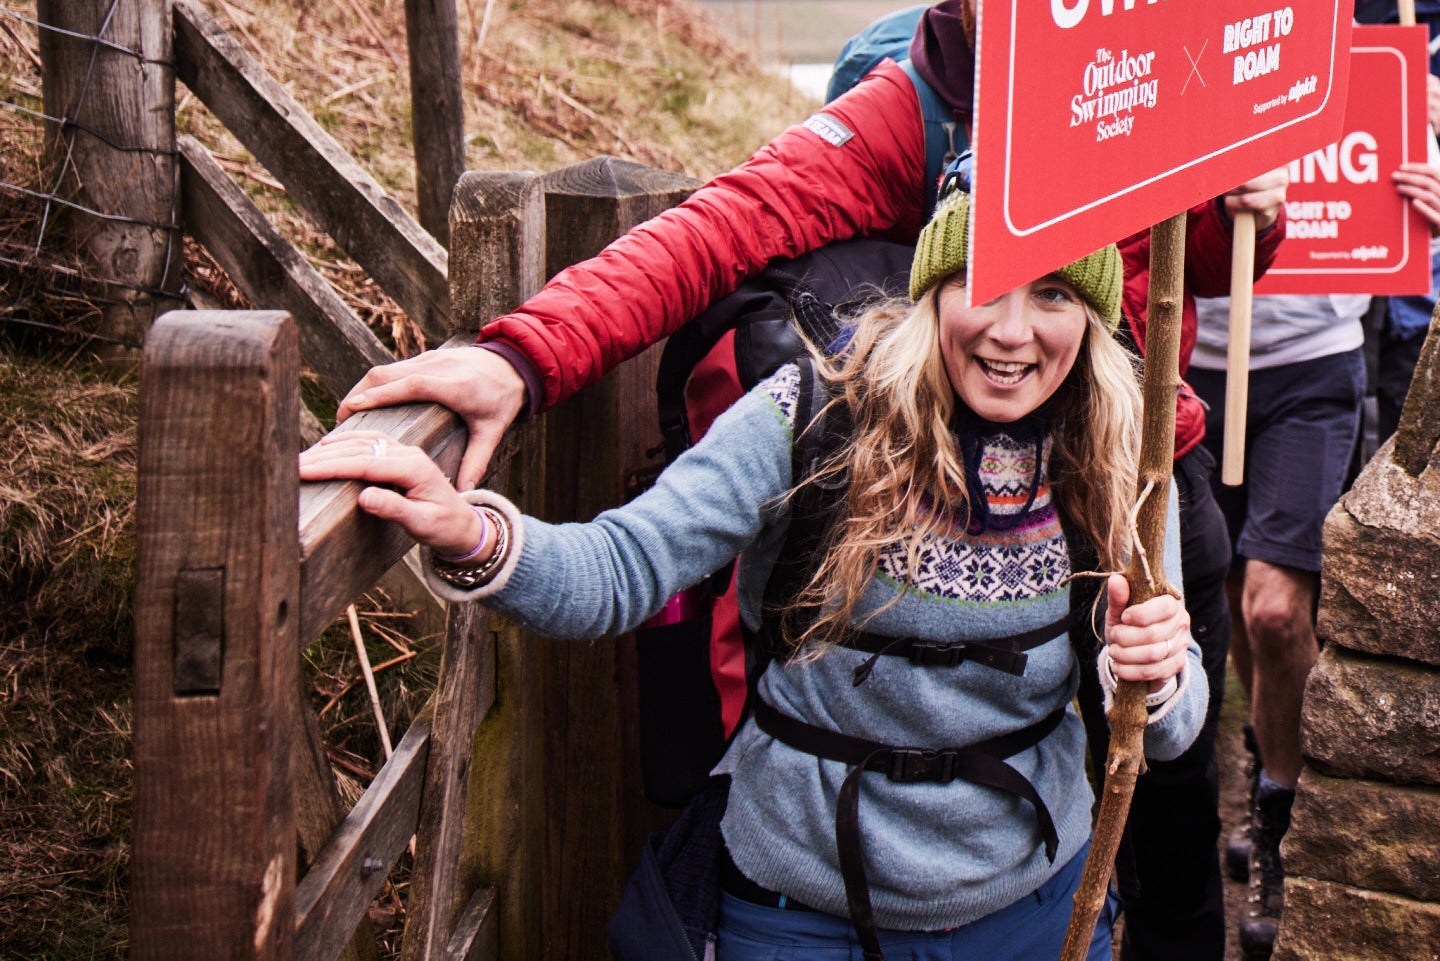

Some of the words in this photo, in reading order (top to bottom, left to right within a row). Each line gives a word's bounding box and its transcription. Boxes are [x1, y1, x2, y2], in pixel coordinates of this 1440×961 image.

[1223, 13, 1272, 54] RIGHT
[1274, 6, 1294, 38] TO
[1083, 49, 1155, 97] Outdoor
[1095, 47, 1111, 64] The
[1233, 43, 1281, 85] ROAM
[1069, 79, 1159, 127] Swimming
[1252, 95, 1280, 115] Supported
[1287, 74, 1318, 103] alpkit
[1096, 115, 1135, 142] Society
[1326, 200, 1352, 221] TO
